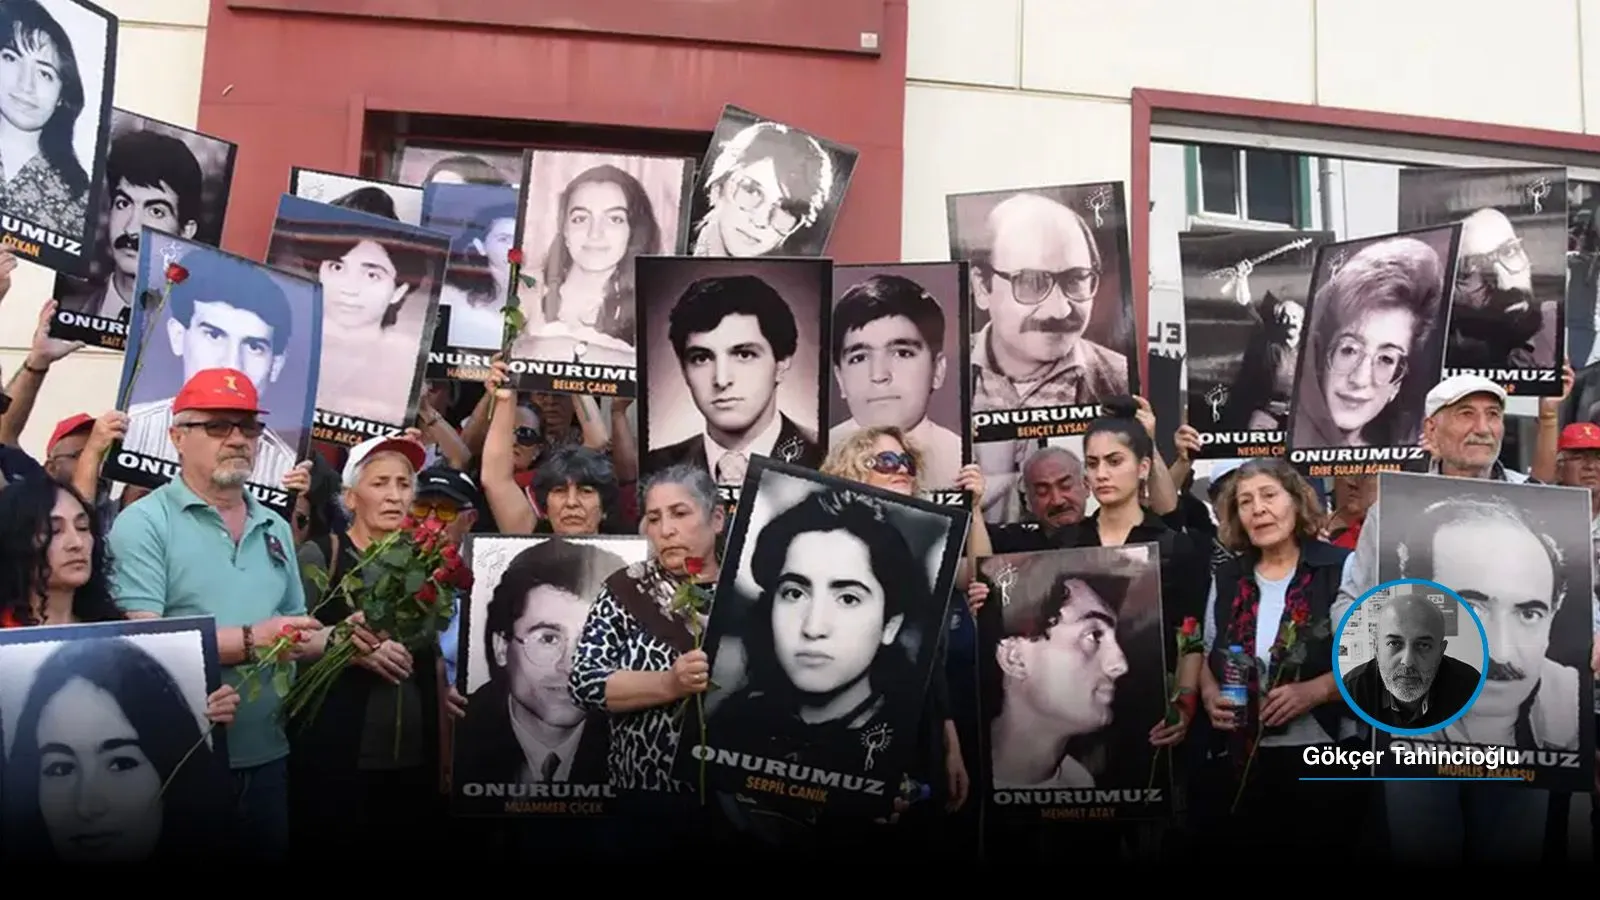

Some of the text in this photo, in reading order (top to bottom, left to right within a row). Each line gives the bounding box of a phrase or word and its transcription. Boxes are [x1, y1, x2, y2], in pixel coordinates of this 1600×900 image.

[58, 311, 130, 335] ONUR
[1199, 431, 1287, 444] ONURU
[1290, 446, 1424, 463] ONURUMUZ
[691, 744, 886, 796] ONURUMUZ
[993, 788, 1163, 804] ONURUMUZ
[504, 801, 567, 813] MUAMMER
